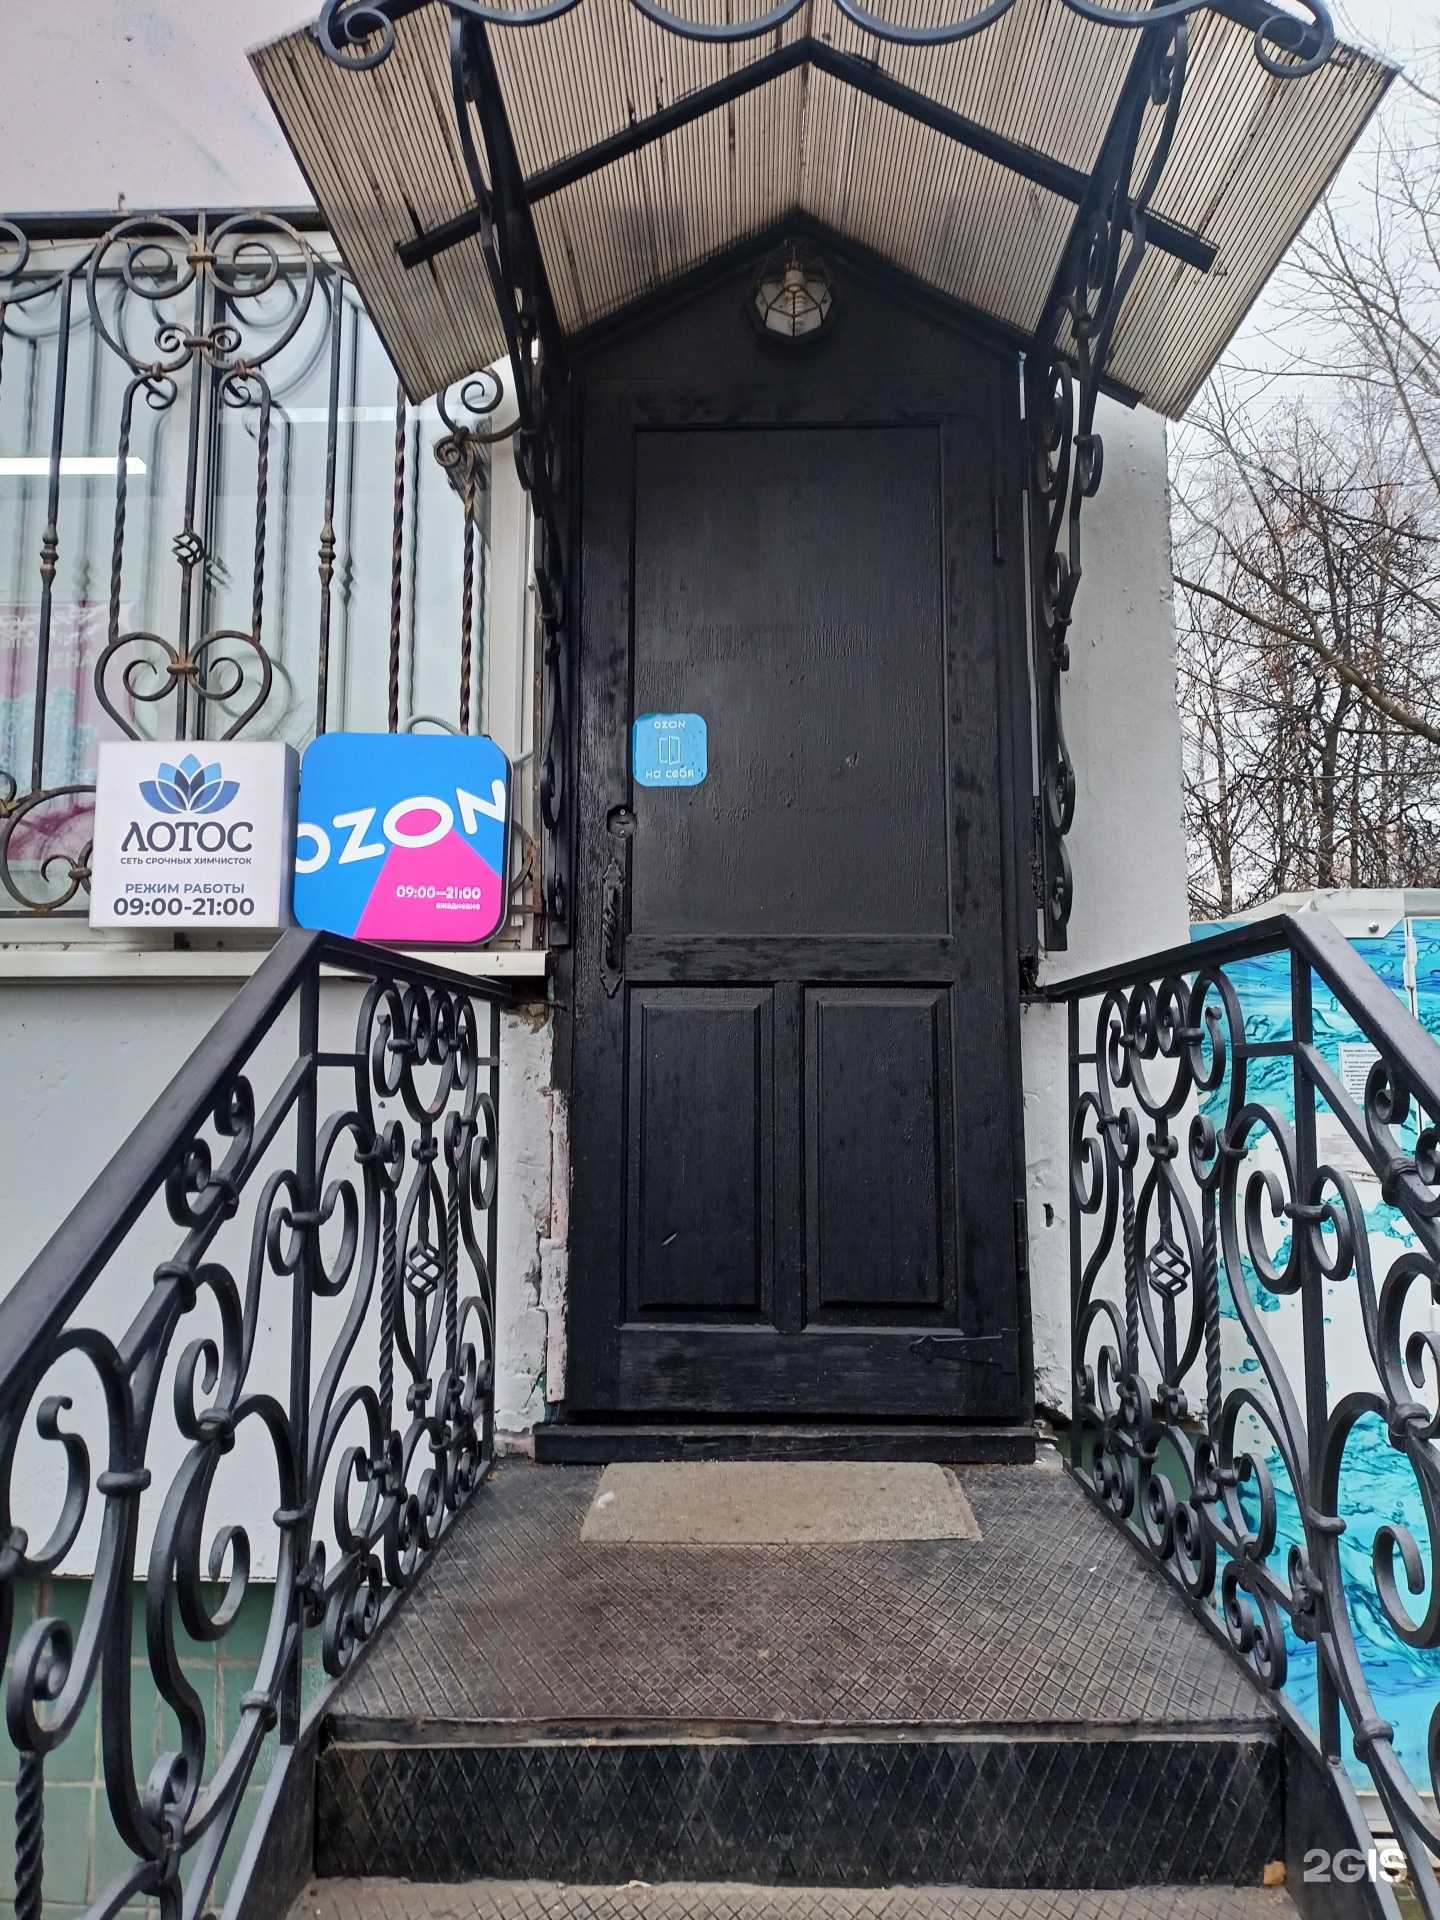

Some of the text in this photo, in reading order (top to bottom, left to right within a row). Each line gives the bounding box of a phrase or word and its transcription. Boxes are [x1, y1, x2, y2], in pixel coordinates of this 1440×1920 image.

[654, 720, 686, 729] OZON
[296, 779, 506, 874] OZON
[121, 821, 254, 852] ЛОТОС
[120, 857, 252, 865] СЕТЬ СРОЧНЫХ ХИМЧИСТОК
[125, 883, 245, 894] РЕЖИМ РАБОТЫ
[113, 897, 255, 916] 09:00-21:00
